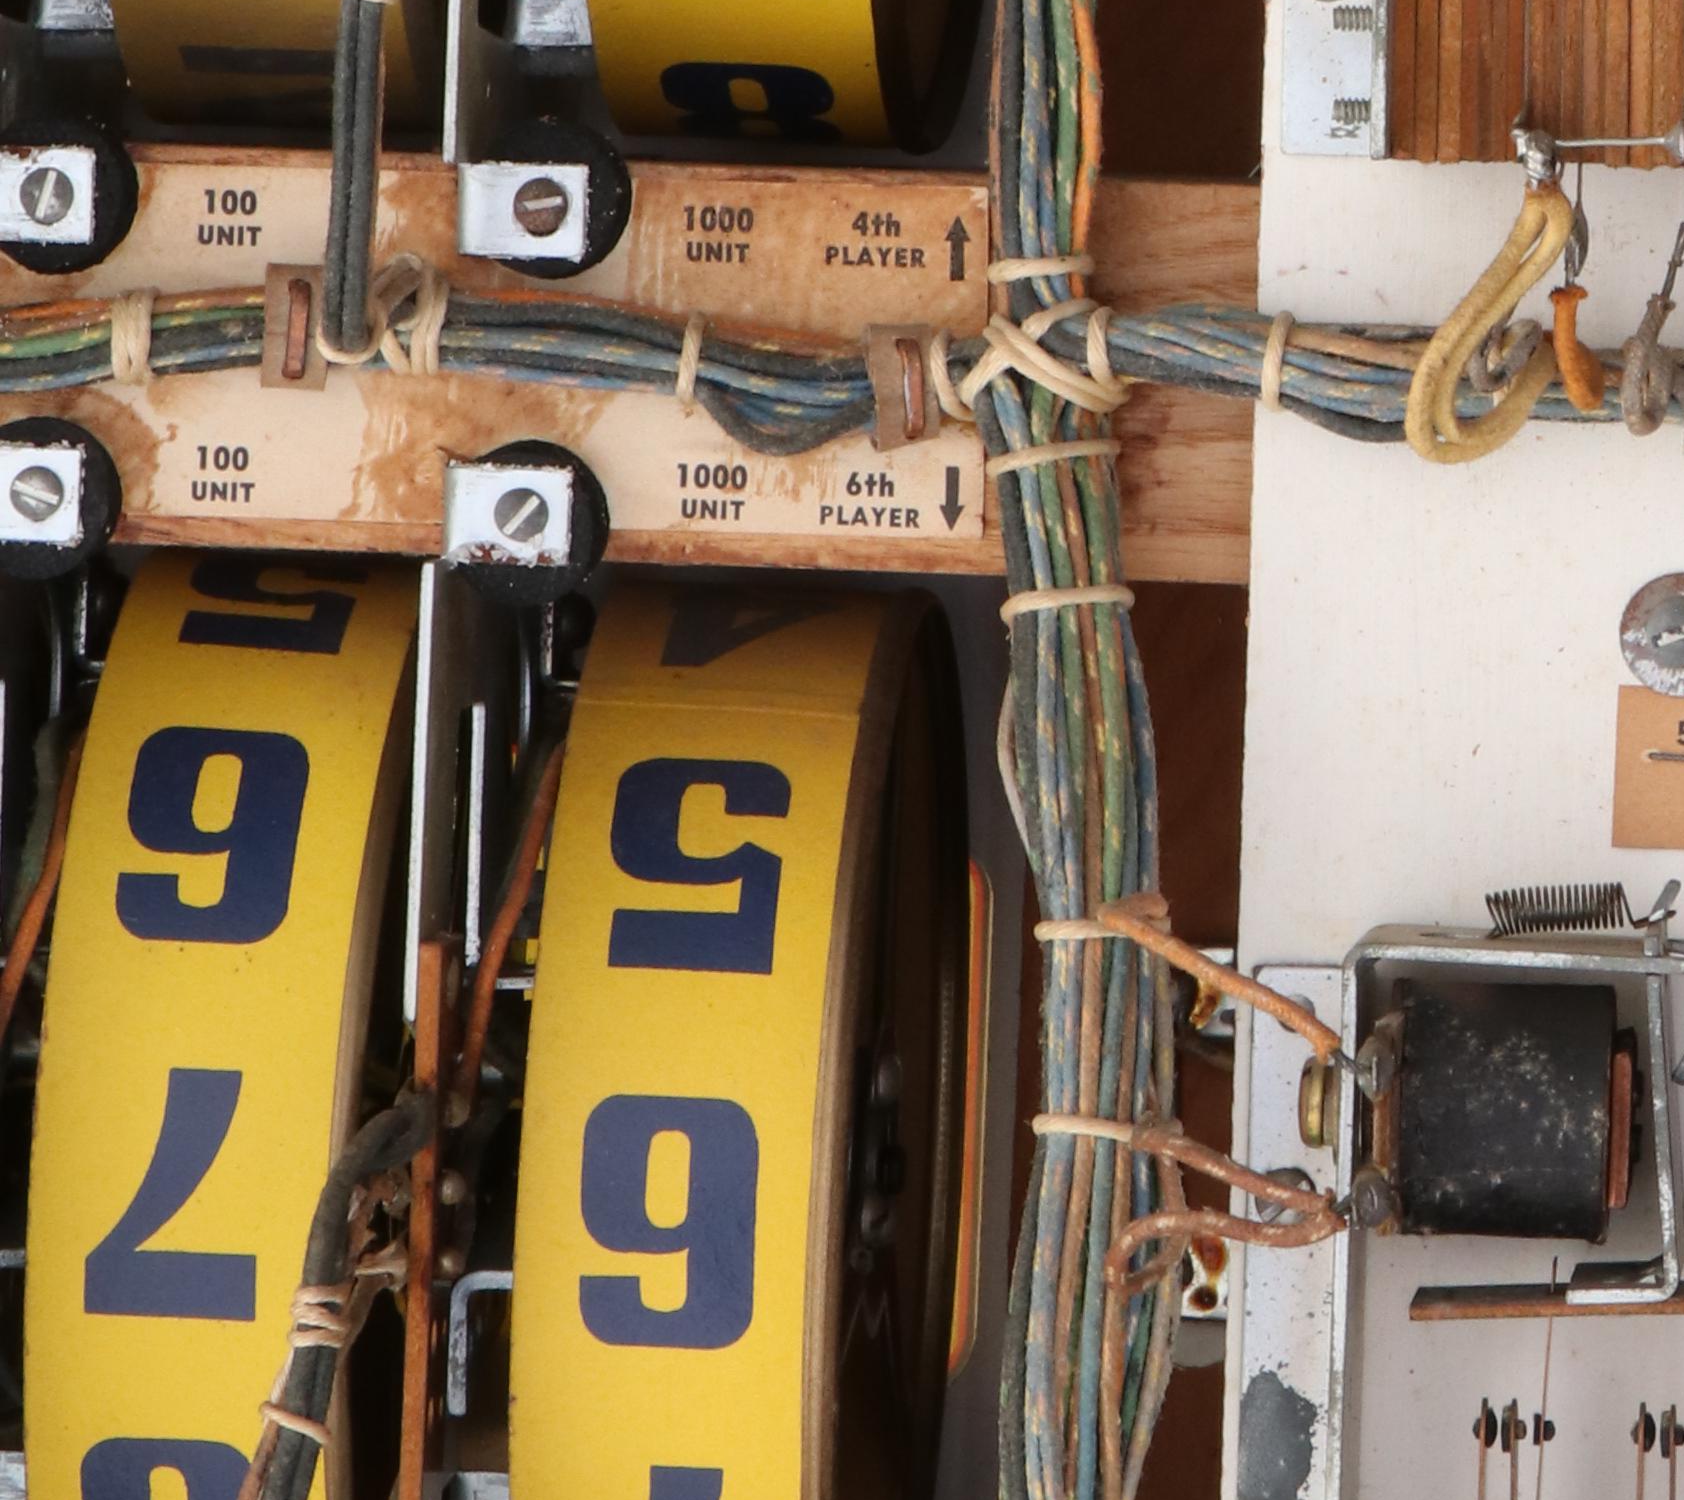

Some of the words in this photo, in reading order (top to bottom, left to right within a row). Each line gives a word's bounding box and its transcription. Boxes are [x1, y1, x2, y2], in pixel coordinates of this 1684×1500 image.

[204, 188, 258, 216] 100
[683, 205, 755, 234] 1000
[851, 210, 901, 238] 4th
[197, 224, 263, 247] UNIT
[686, 241, 750, 264] UNIT
[824, 245, 926, 269] PLAYER
[197, 445, 249, 472] 100
[677, 463, 748, 492] 1000
[845, 471, 895, 498] 6th
[191, 480, 256, 503] UNIT
[681, 498, 746, 521] UNIT
[819, 505, 920, 529] PLAYER
[607, 758, 791, 975] 5
[84, 1068, 257, 1321] 7
